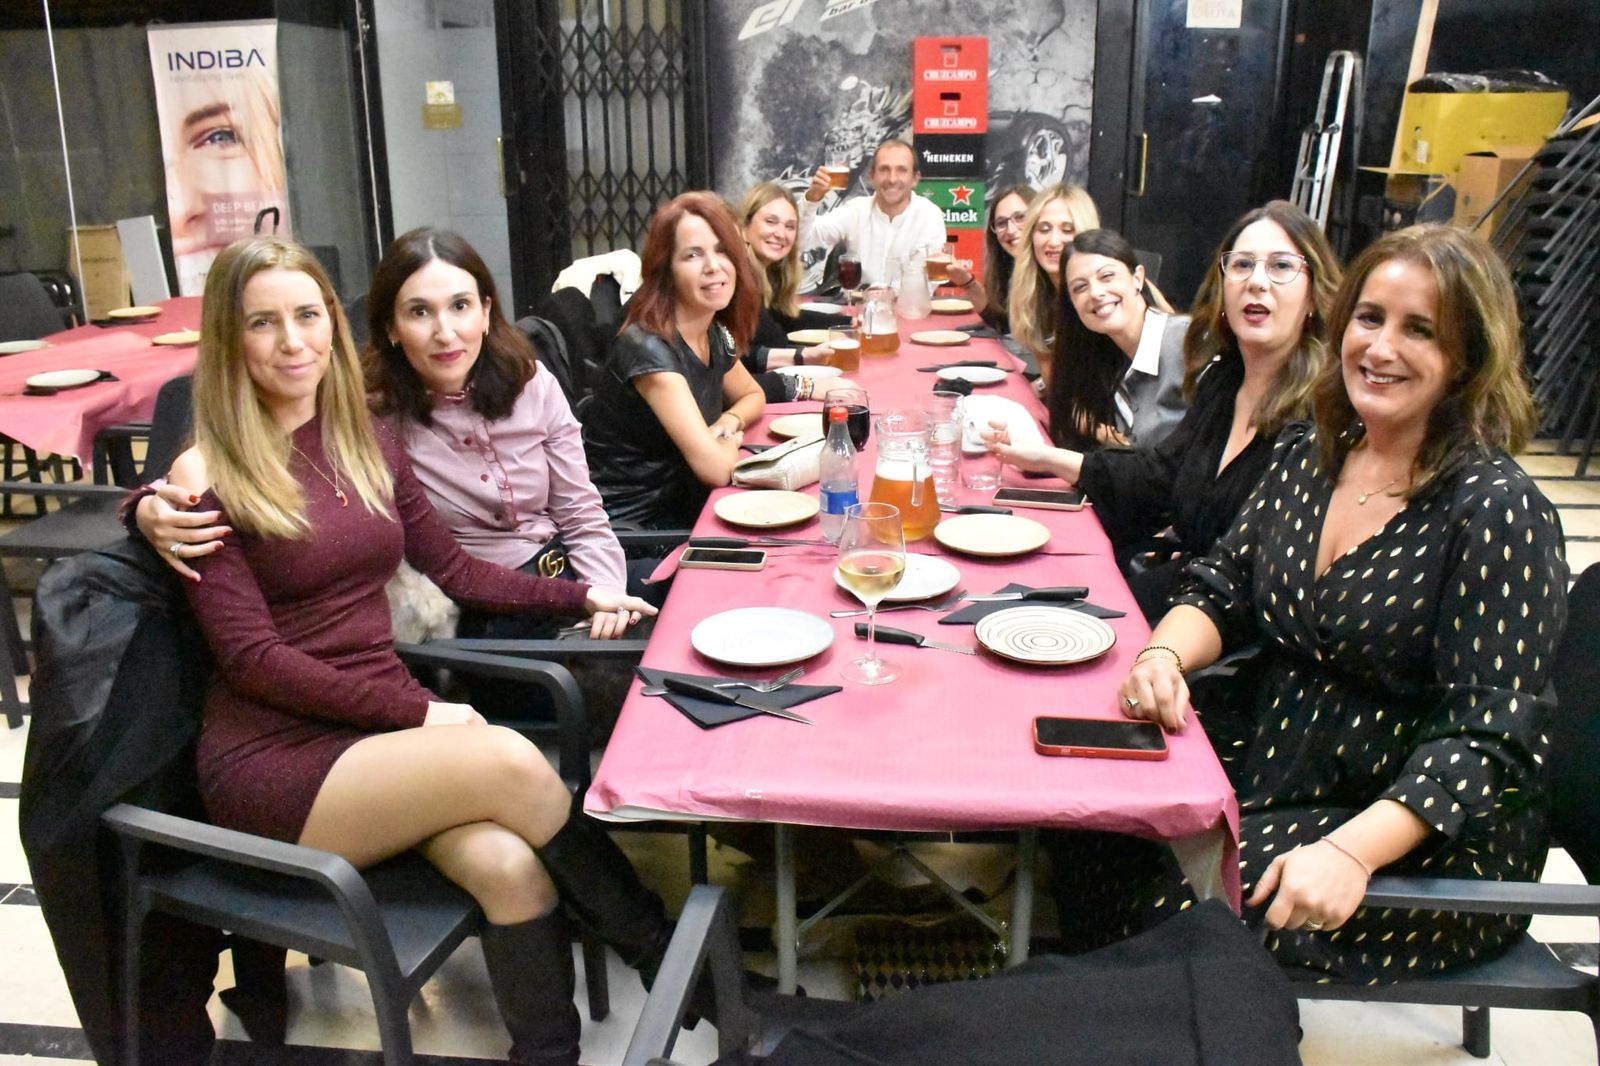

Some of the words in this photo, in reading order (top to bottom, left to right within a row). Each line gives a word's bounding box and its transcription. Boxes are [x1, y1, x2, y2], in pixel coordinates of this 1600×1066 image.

[168, 49, 265, 71] INDIBA
[924, 69, 977, 80] CRUZCAMPO
[924, 117, 977, 129] CRUZCAMPO
[926, 154, 974, 163] HEINEKEN
